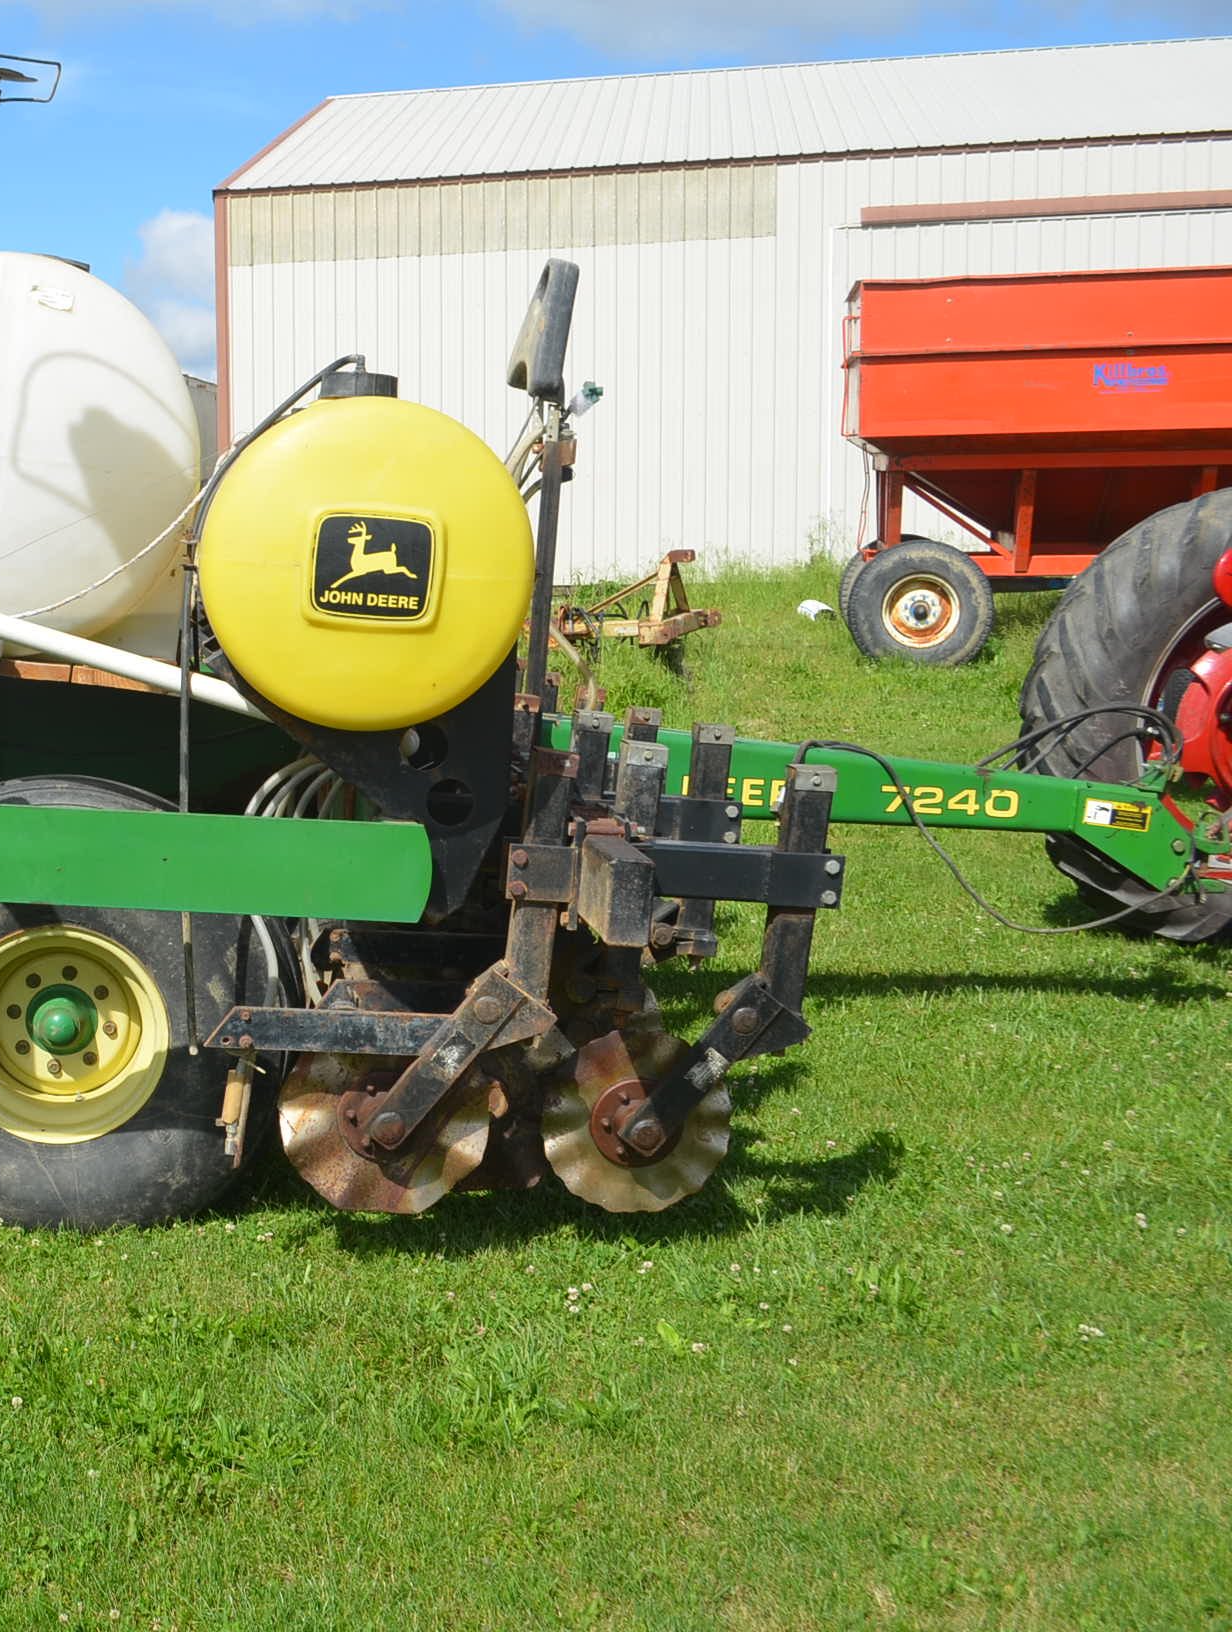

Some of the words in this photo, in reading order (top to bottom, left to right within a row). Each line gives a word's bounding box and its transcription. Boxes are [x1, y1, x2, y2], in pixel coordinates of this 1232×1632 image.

[320, 590, 363, 605] JOHN
[367, 594, 419, 609] DEERE
[881, 785, 1019, 818] 7240
